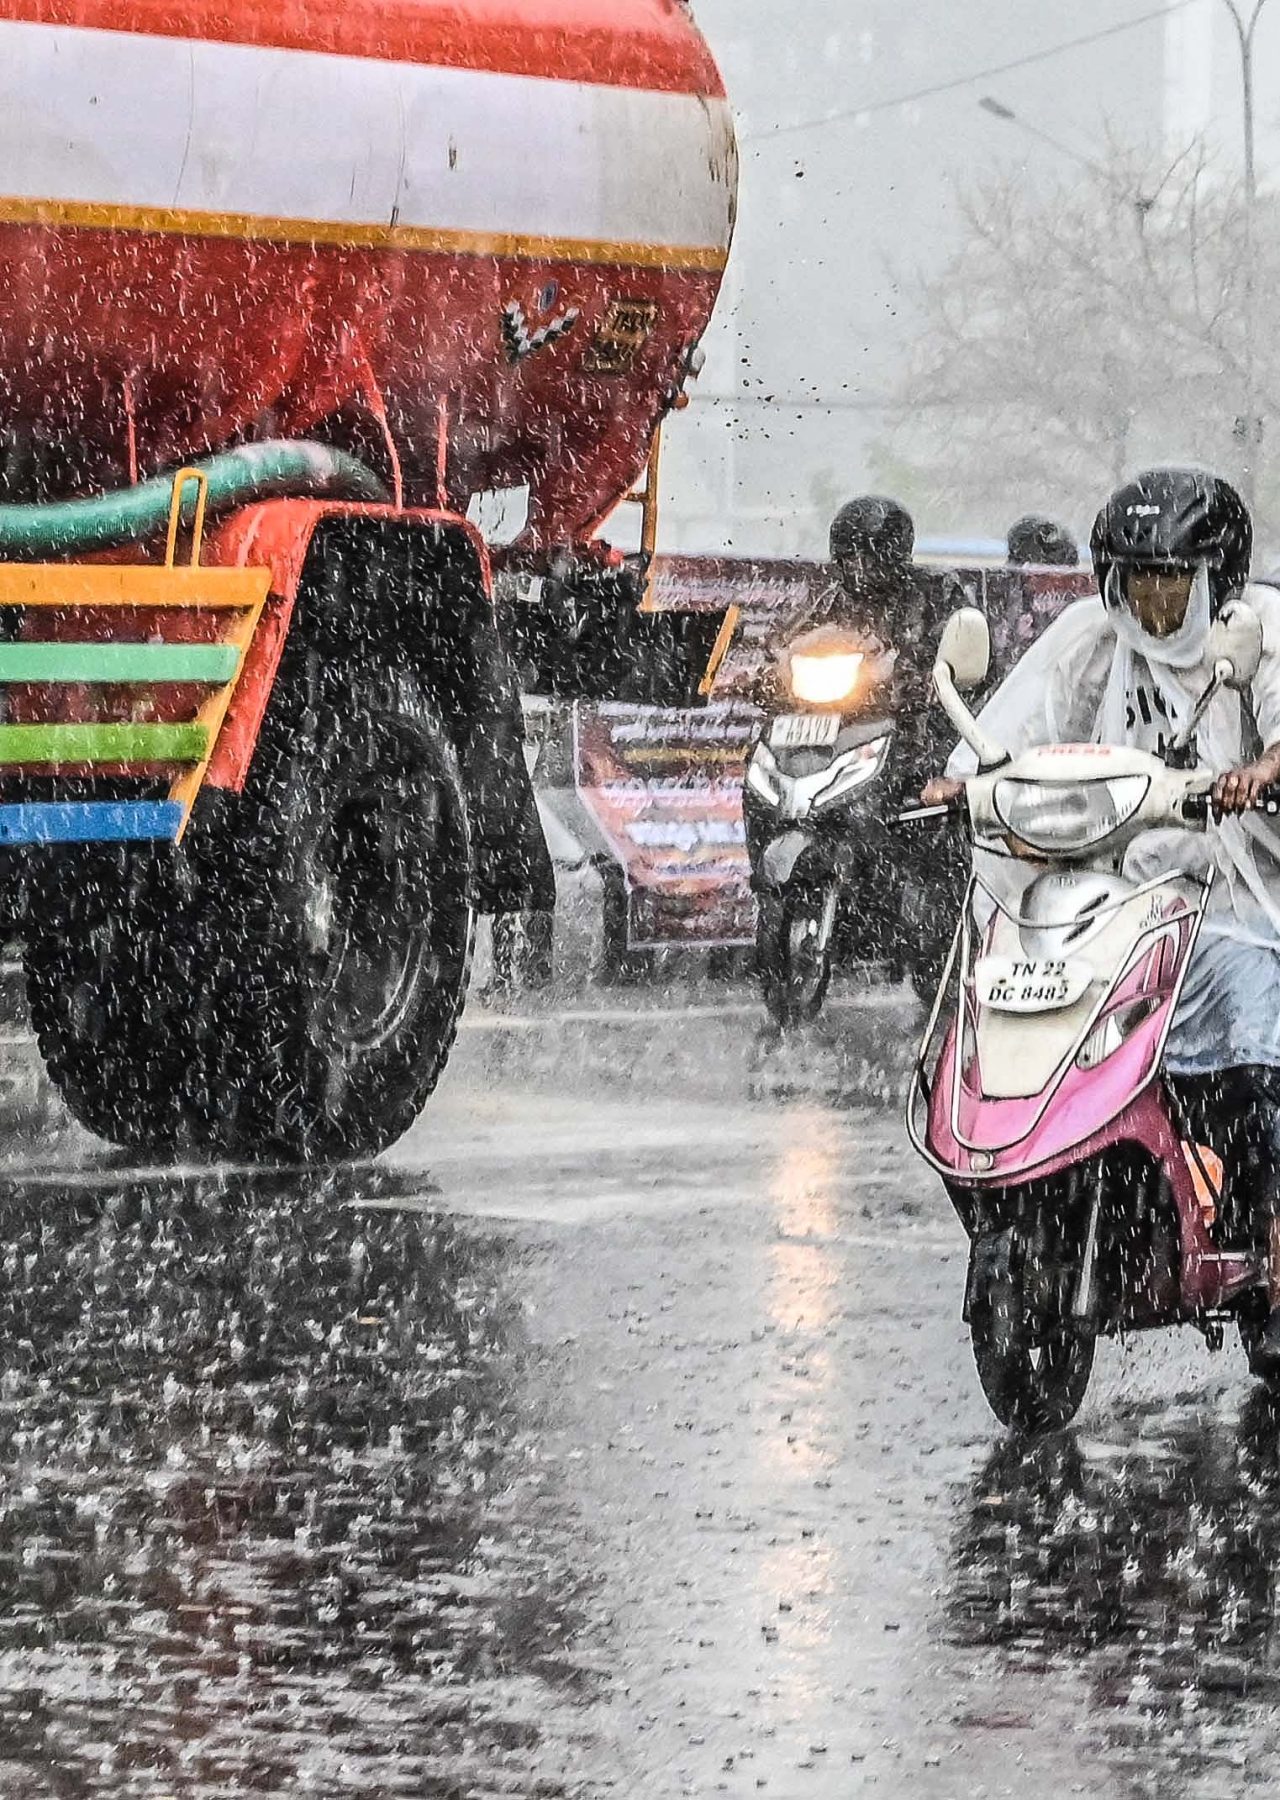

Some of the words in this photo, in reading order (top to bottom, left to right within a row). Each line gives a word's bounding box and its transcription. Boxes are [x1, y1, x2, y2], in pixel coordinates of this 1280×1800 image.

[1012, 961, 1037, 977] TN
[1042, 961, 1067, 976] 22
[988, 986, 1015, 1001] DC
